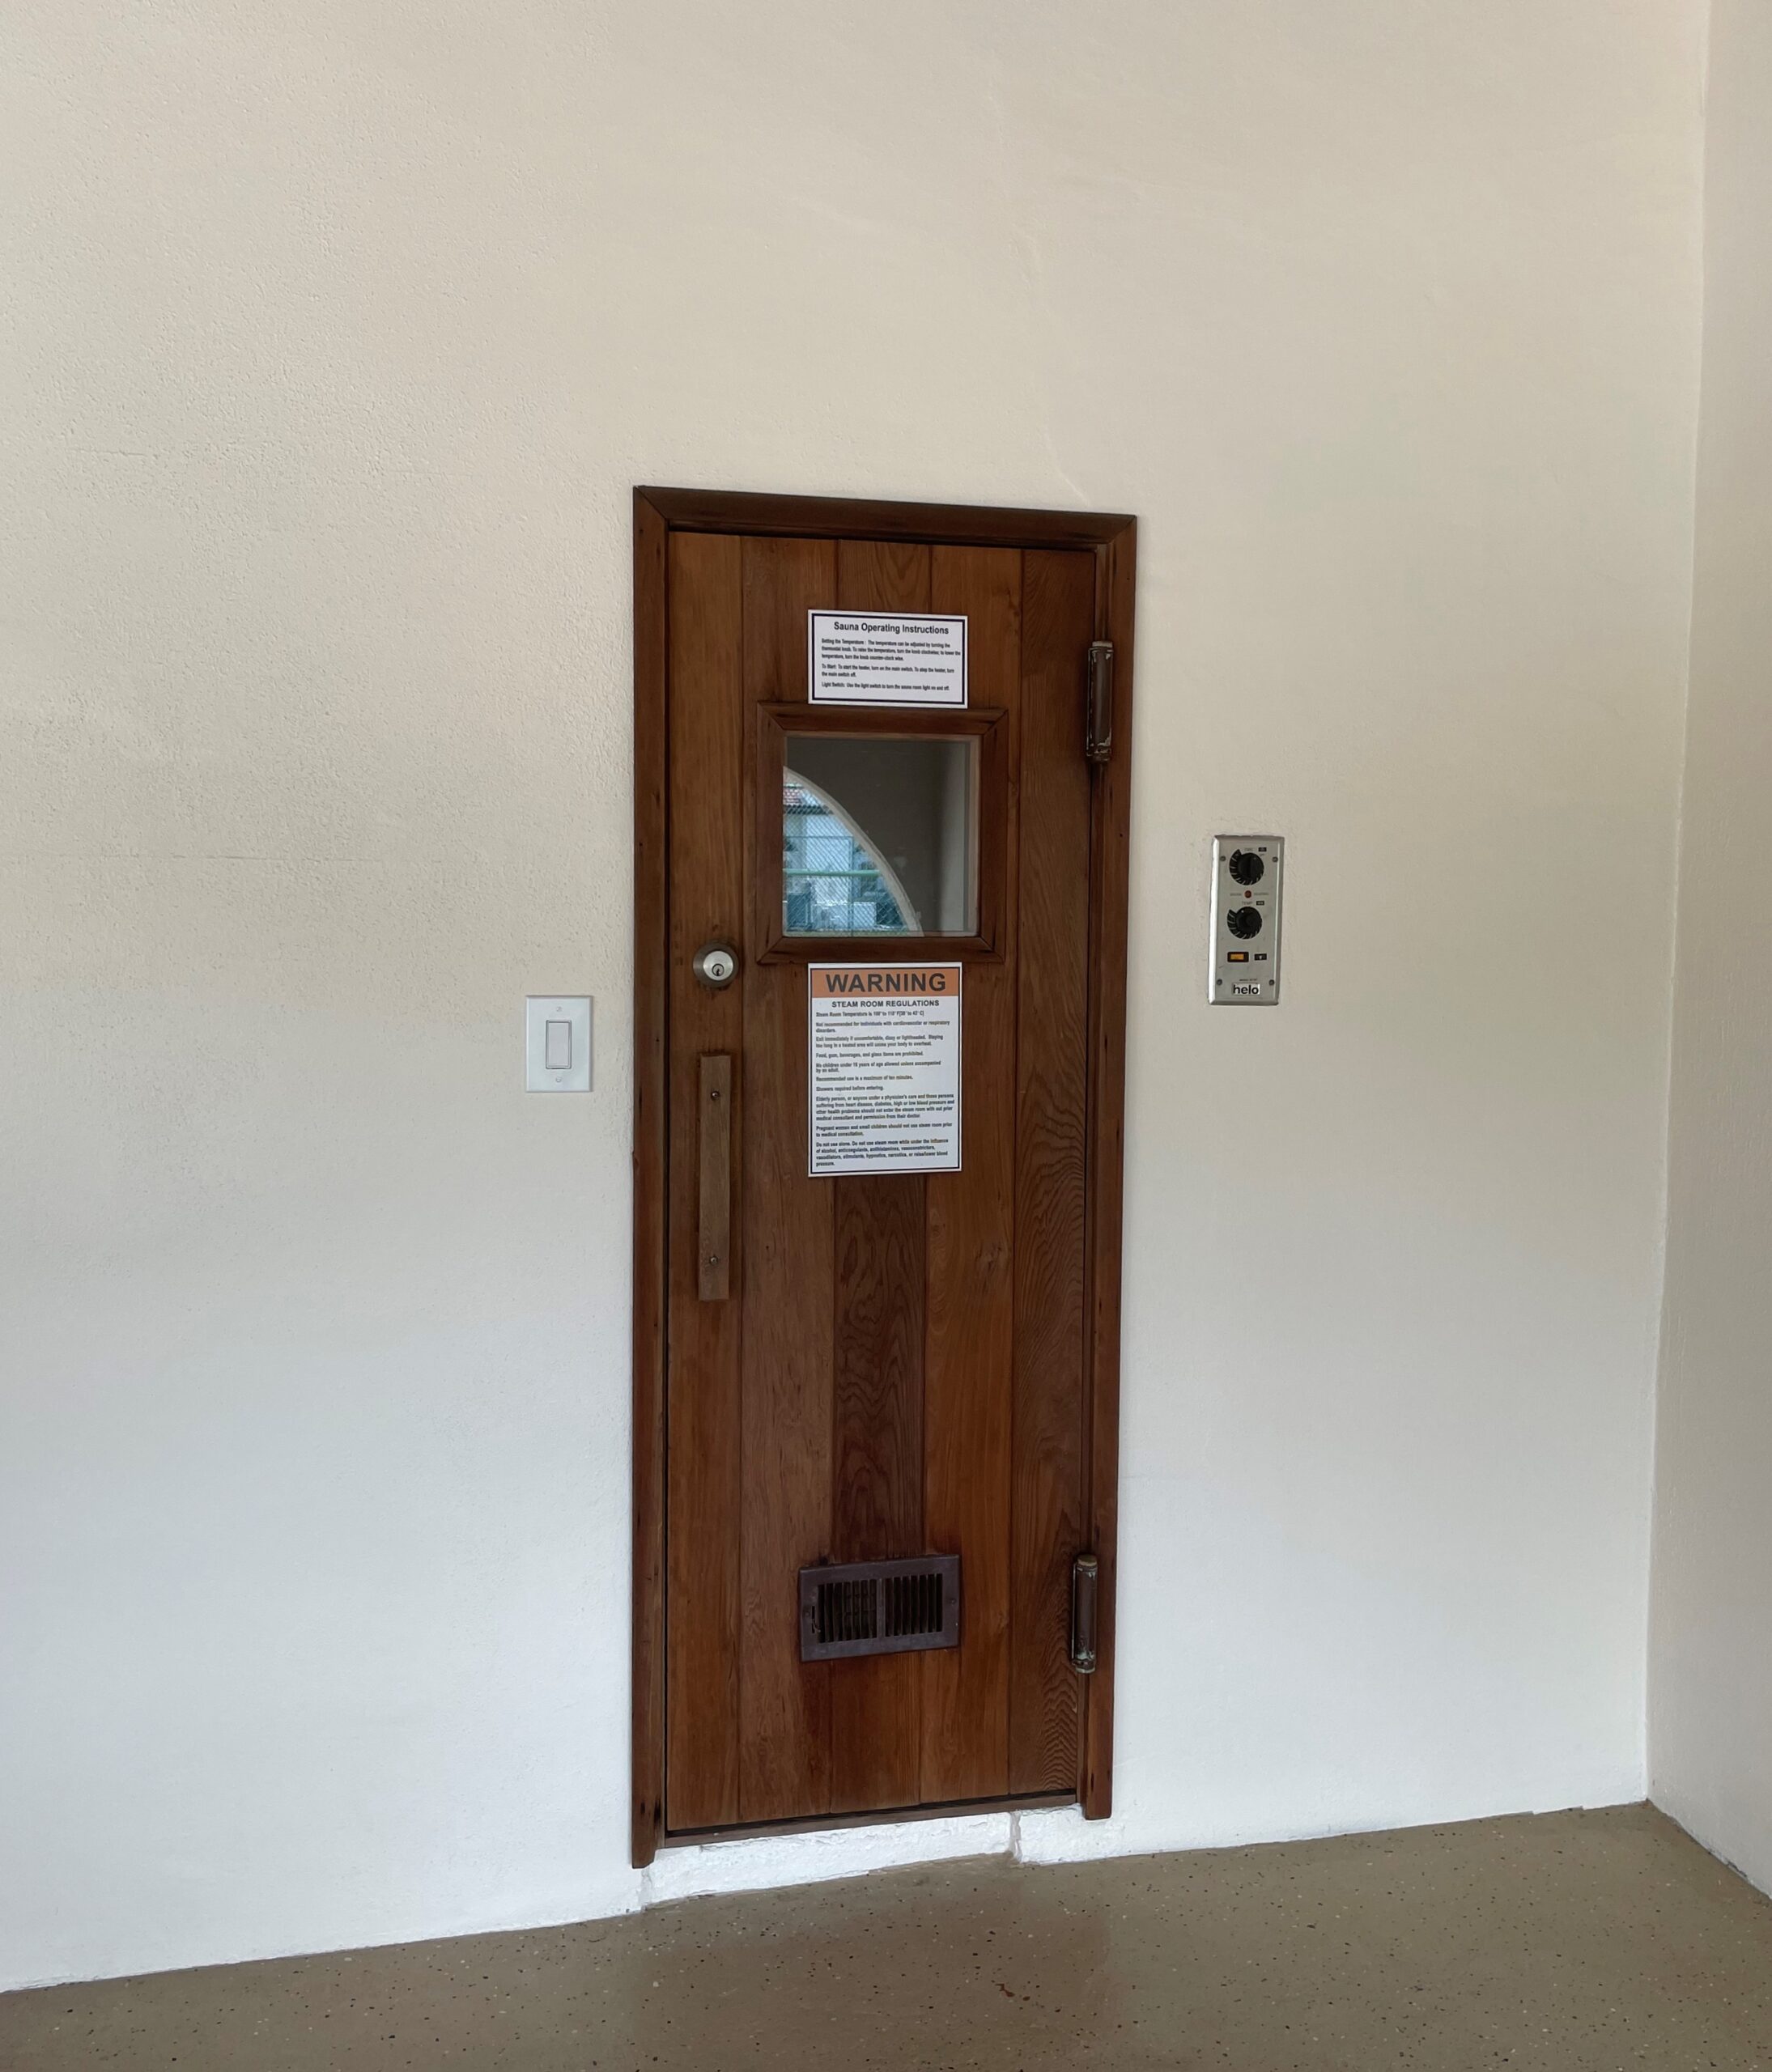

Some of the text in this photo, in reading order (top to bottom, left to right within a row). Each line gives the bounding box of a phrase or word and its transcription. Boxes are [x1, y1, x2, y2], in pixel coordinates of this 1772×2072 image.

[835, 622, 949, 635] Sauna Operating Instructions
[827, 973, 945, 992] WARNING
[1233, 984, 1259, 995] helo
